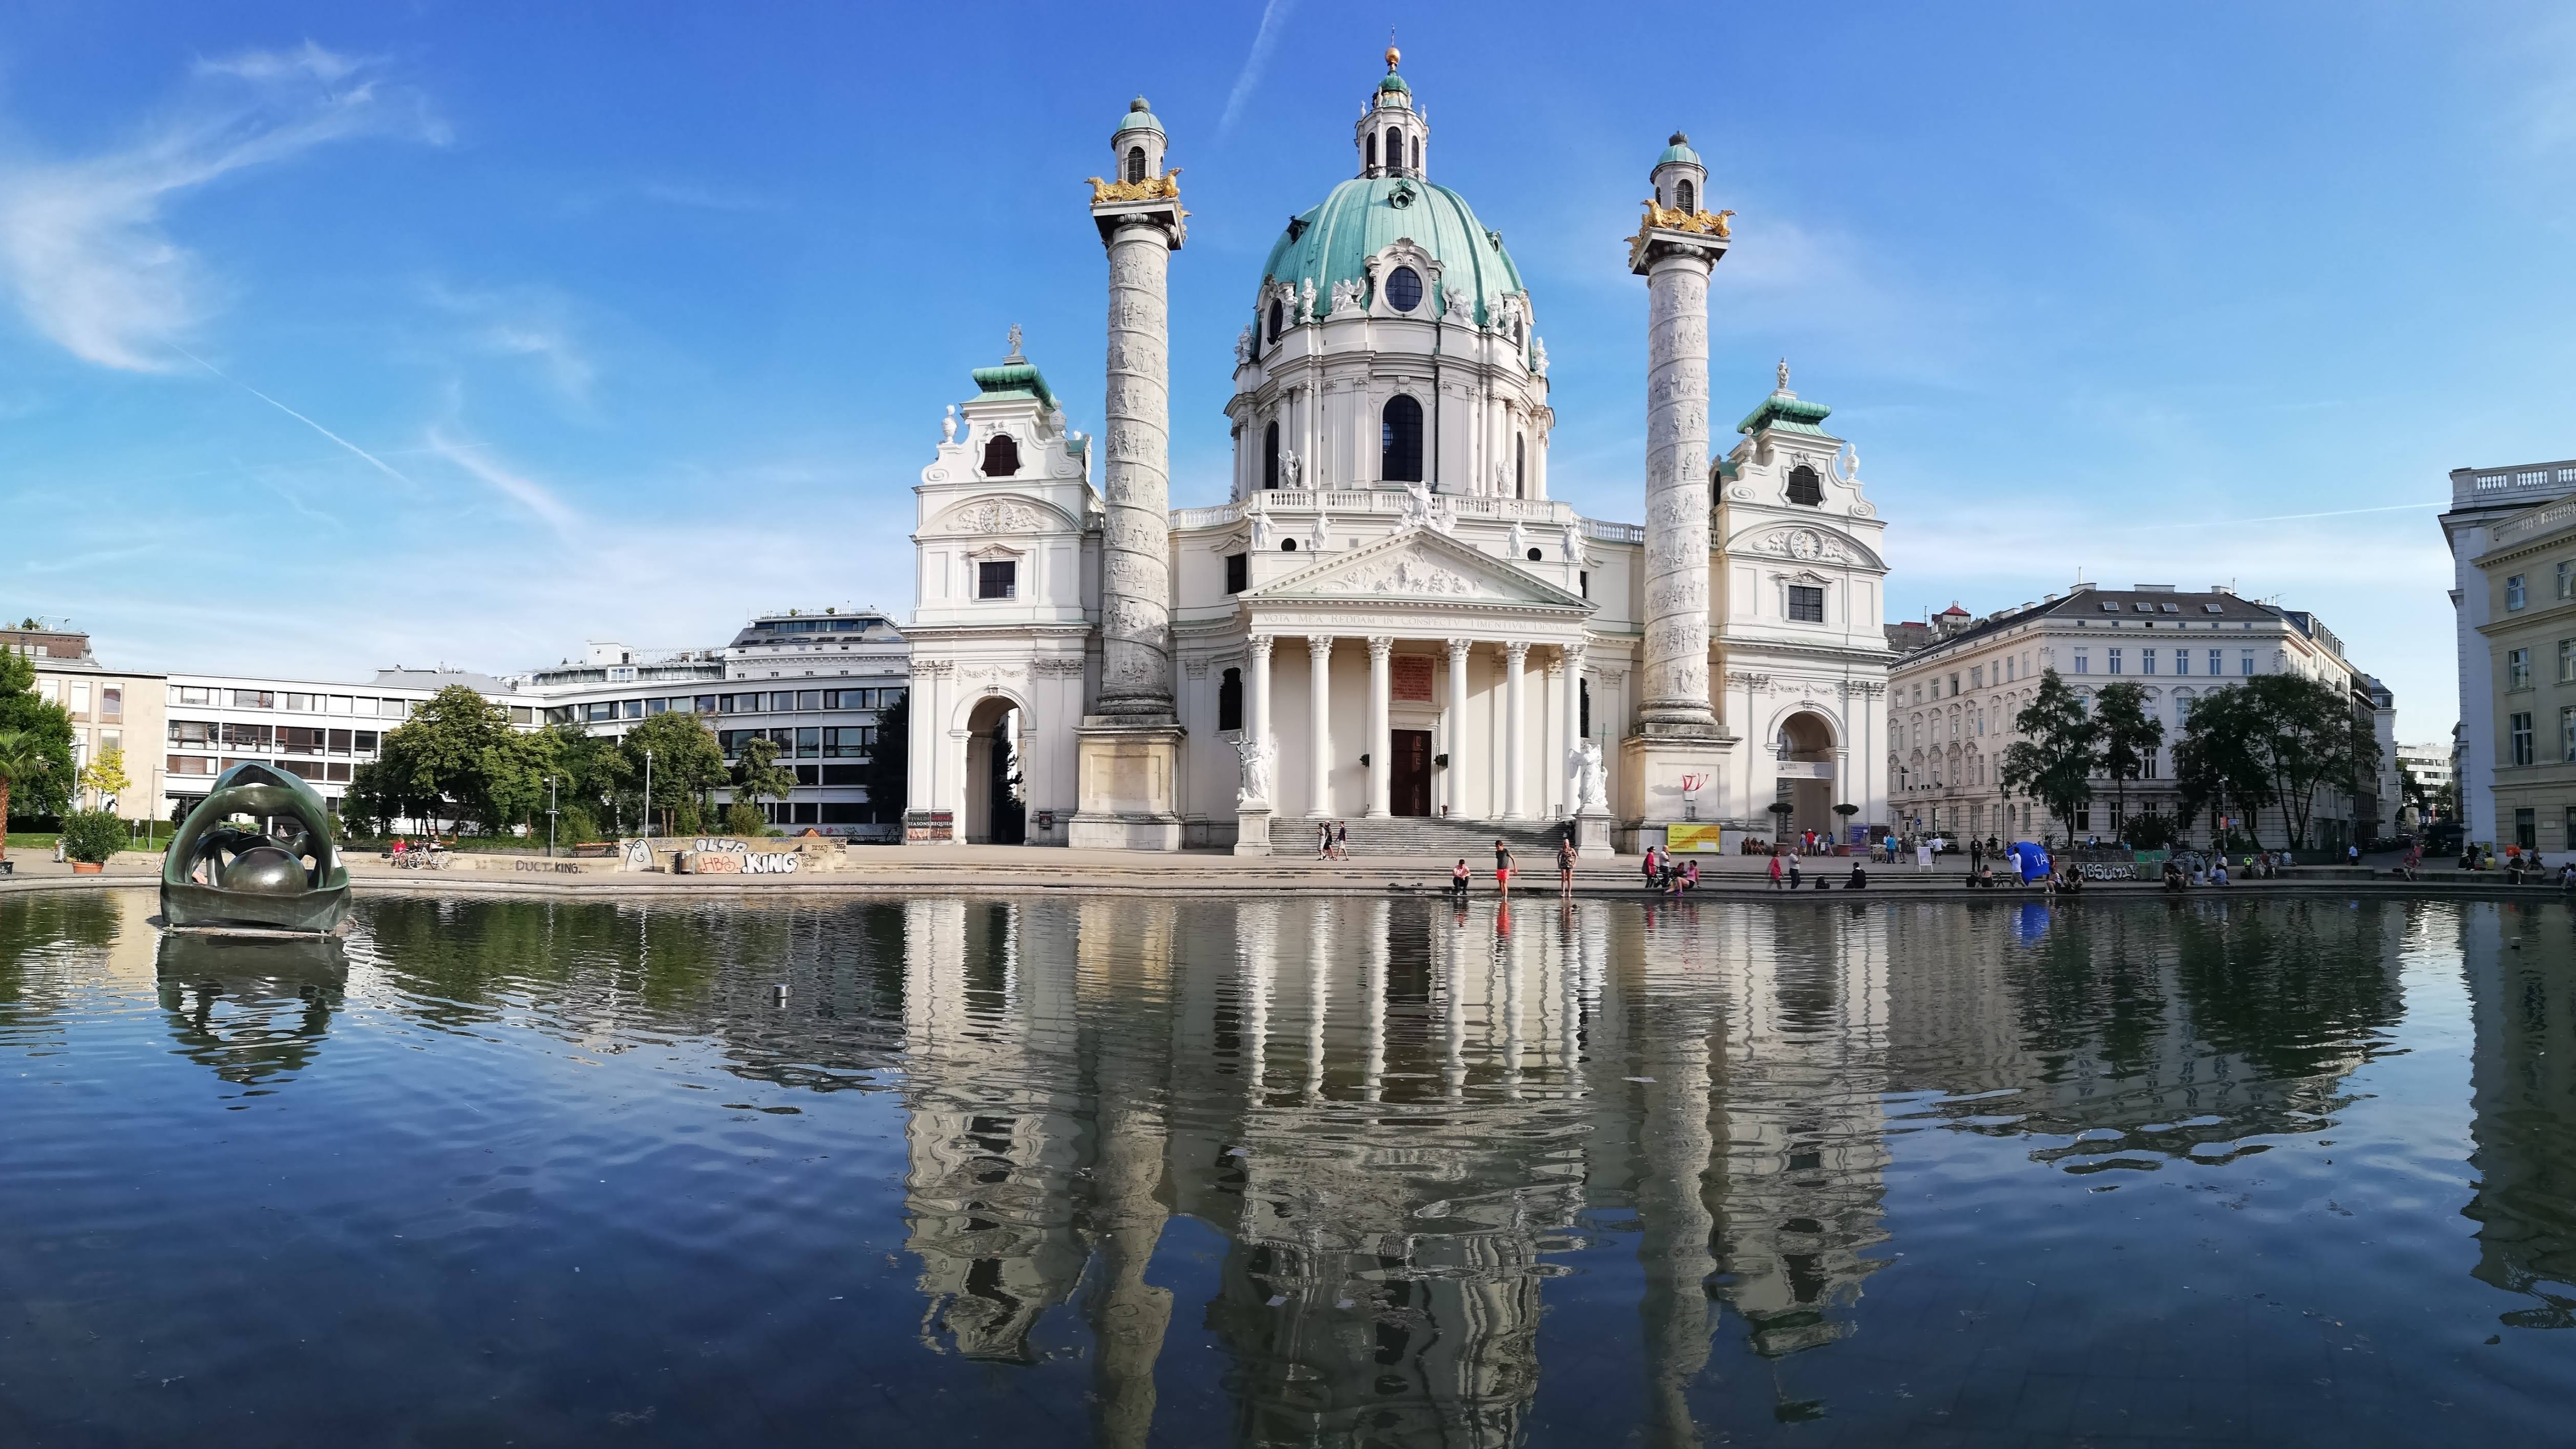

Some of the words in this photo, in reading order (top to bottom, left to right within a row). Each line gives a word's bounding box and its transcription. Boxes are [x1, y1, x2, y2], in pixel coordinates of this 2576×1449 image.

[1262, 613, 1290, 622] VOTA
[1298, 614, 1323, 623] MEA
[1331, 614, 1375, 624] REDDAM
[1383, 615, 1393, 625] IN
[1401, 617, 1460, 626] CONSPECTV
[1534, 622, 1563, 632] DEVM
